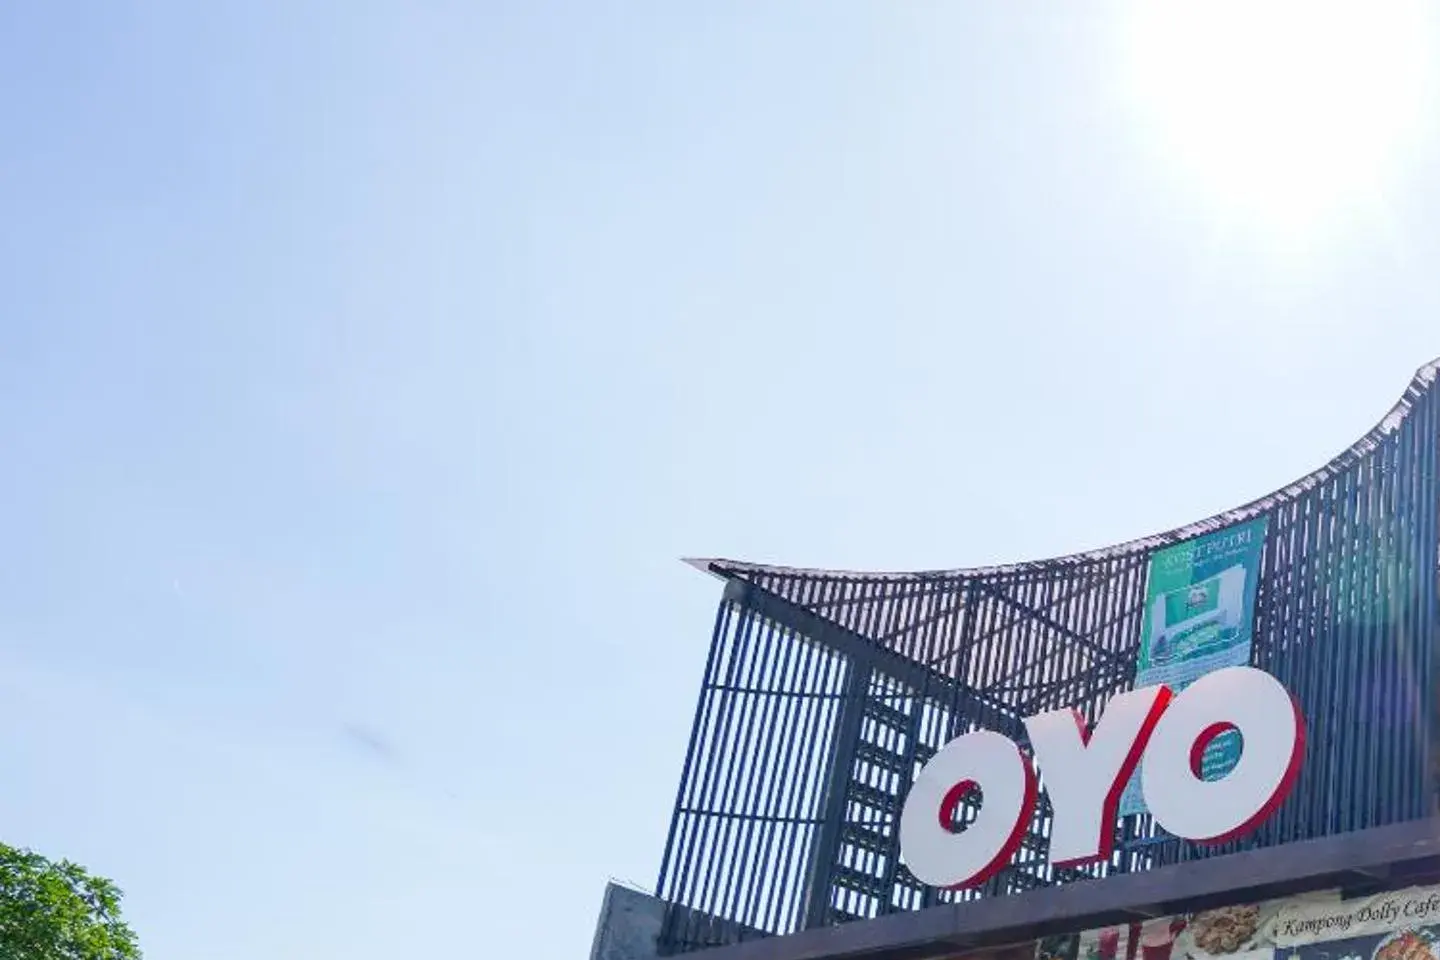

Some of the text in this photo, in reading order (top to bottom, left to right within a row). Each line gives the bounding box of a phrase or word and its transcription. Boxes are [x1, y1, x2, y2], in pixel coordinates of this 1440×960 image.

[900, 666, 1306, 890] OYO
[1281, 913, 1353, 938] Kampong
[1356, 899, 1400, 925] Dolly
